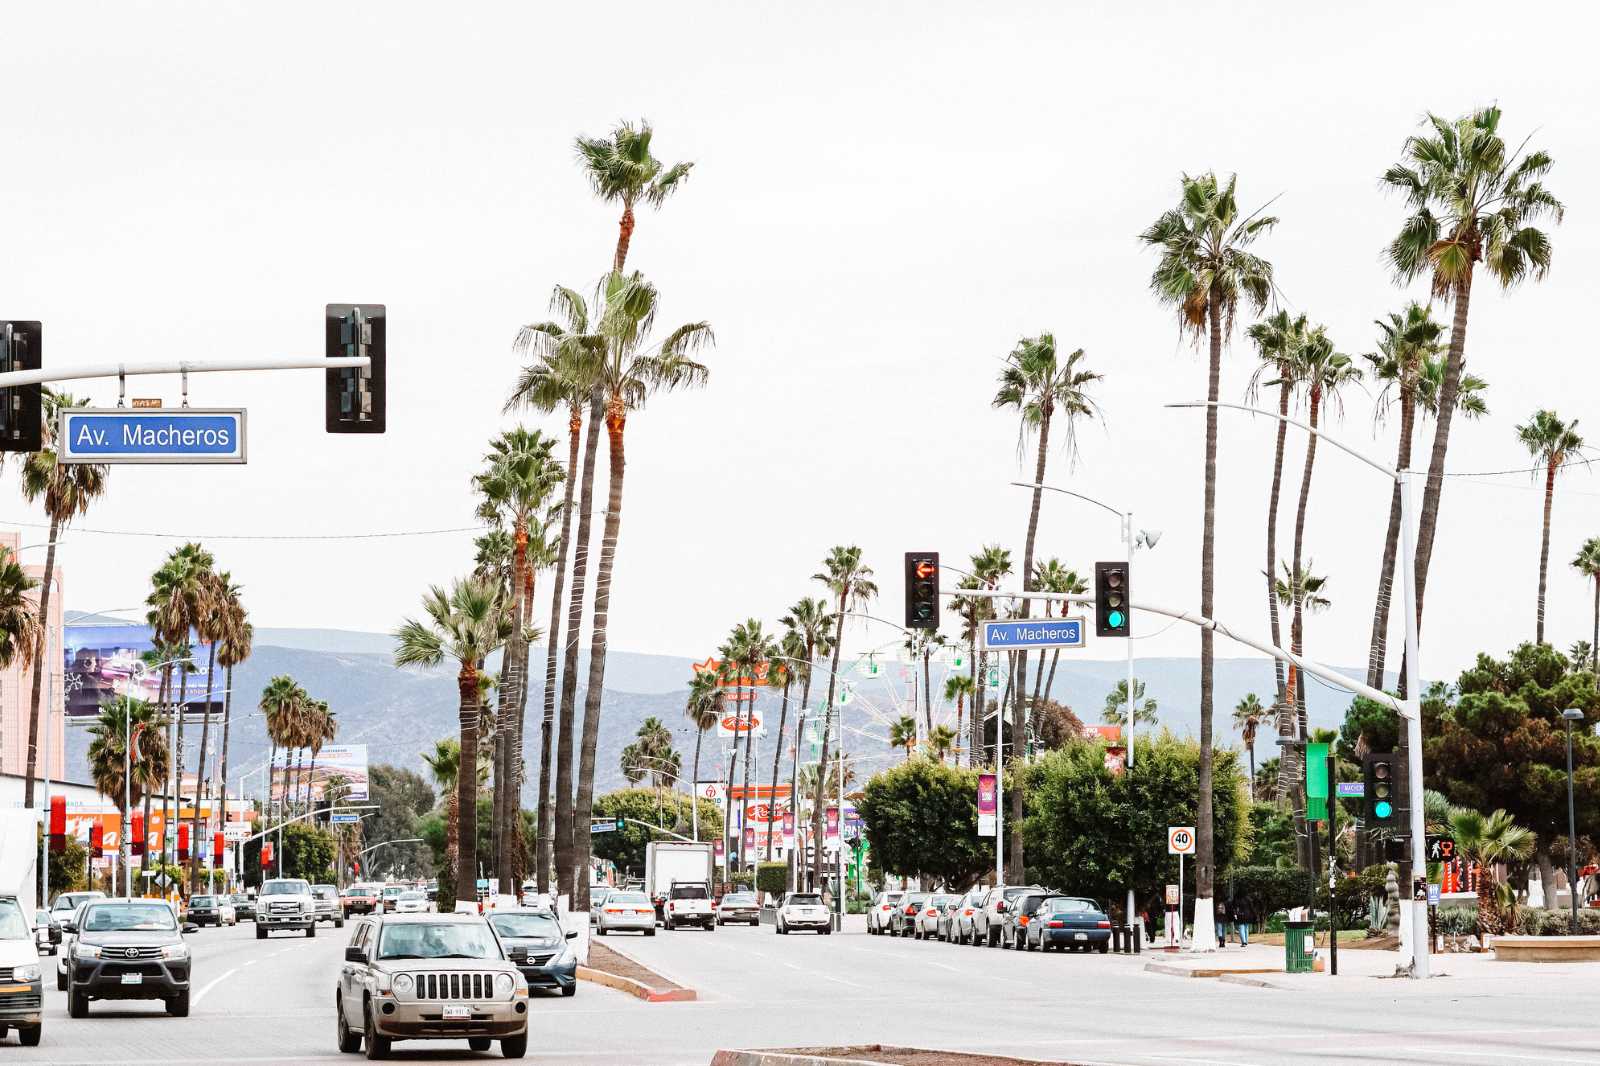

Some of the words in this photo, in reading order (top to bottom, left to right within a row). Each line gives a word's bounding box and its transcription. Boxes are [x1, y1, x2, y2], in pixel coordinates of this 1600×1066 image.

[77, 425, 108, 445] Av.
[124, 425, 228, 445] Macheros
[991, 629, 1009, 641] Av.
[1016, 627, 1076, 641] Macheros
[1175, 833, 1188, 844] 40
